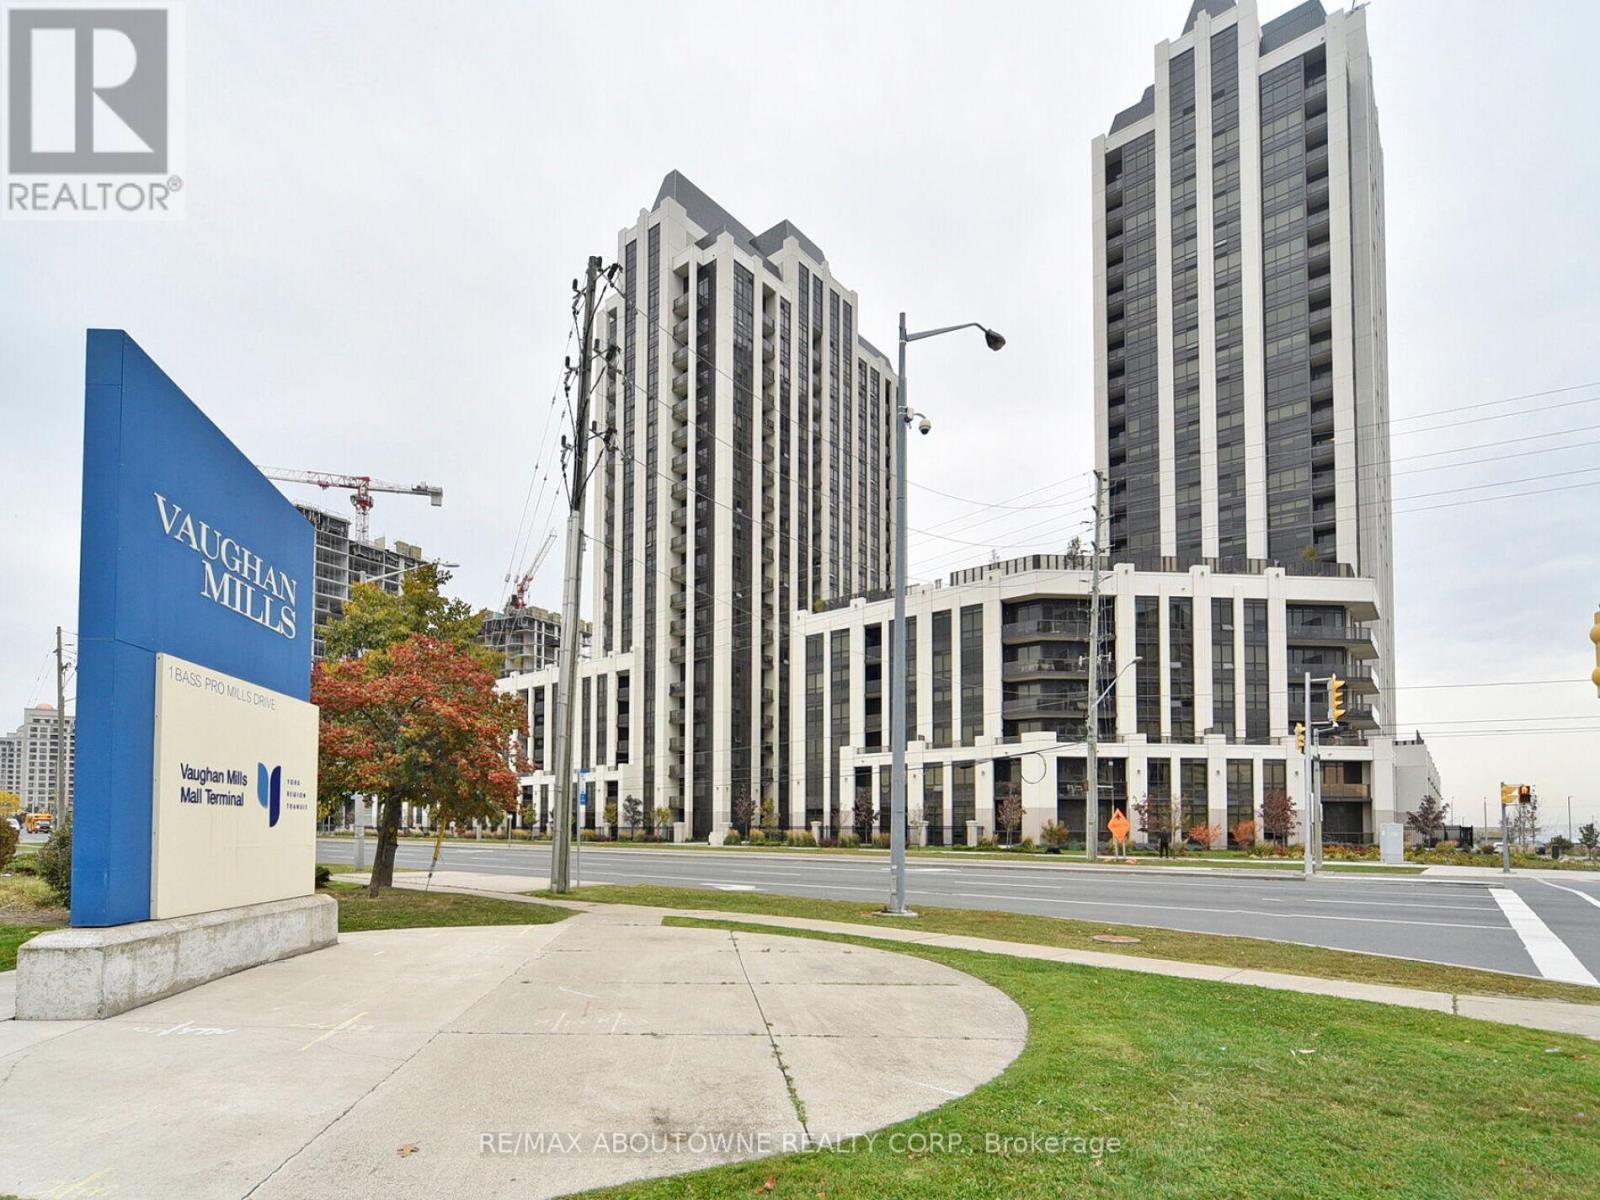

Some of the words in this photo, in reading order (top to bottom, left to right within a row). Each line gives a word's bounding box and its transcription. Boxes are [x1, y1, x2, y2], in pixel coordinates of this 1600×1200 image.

[154, 492, 297, 606] VAUGHAN
[201, 560, 296, 639] MILLS
[175, 667, 202, 688] BASS
[205, 677, 225, 695] PRO
[227, 684, 252, 704] MILLS
[253, 693, 276, 710] DRIVE
[180, 762, 224, 786] Vaughan
[226, 769, 248, 786] Mills
[180, 786, 202, 803] Mall
[205, 788, 244, 806] Terminal
